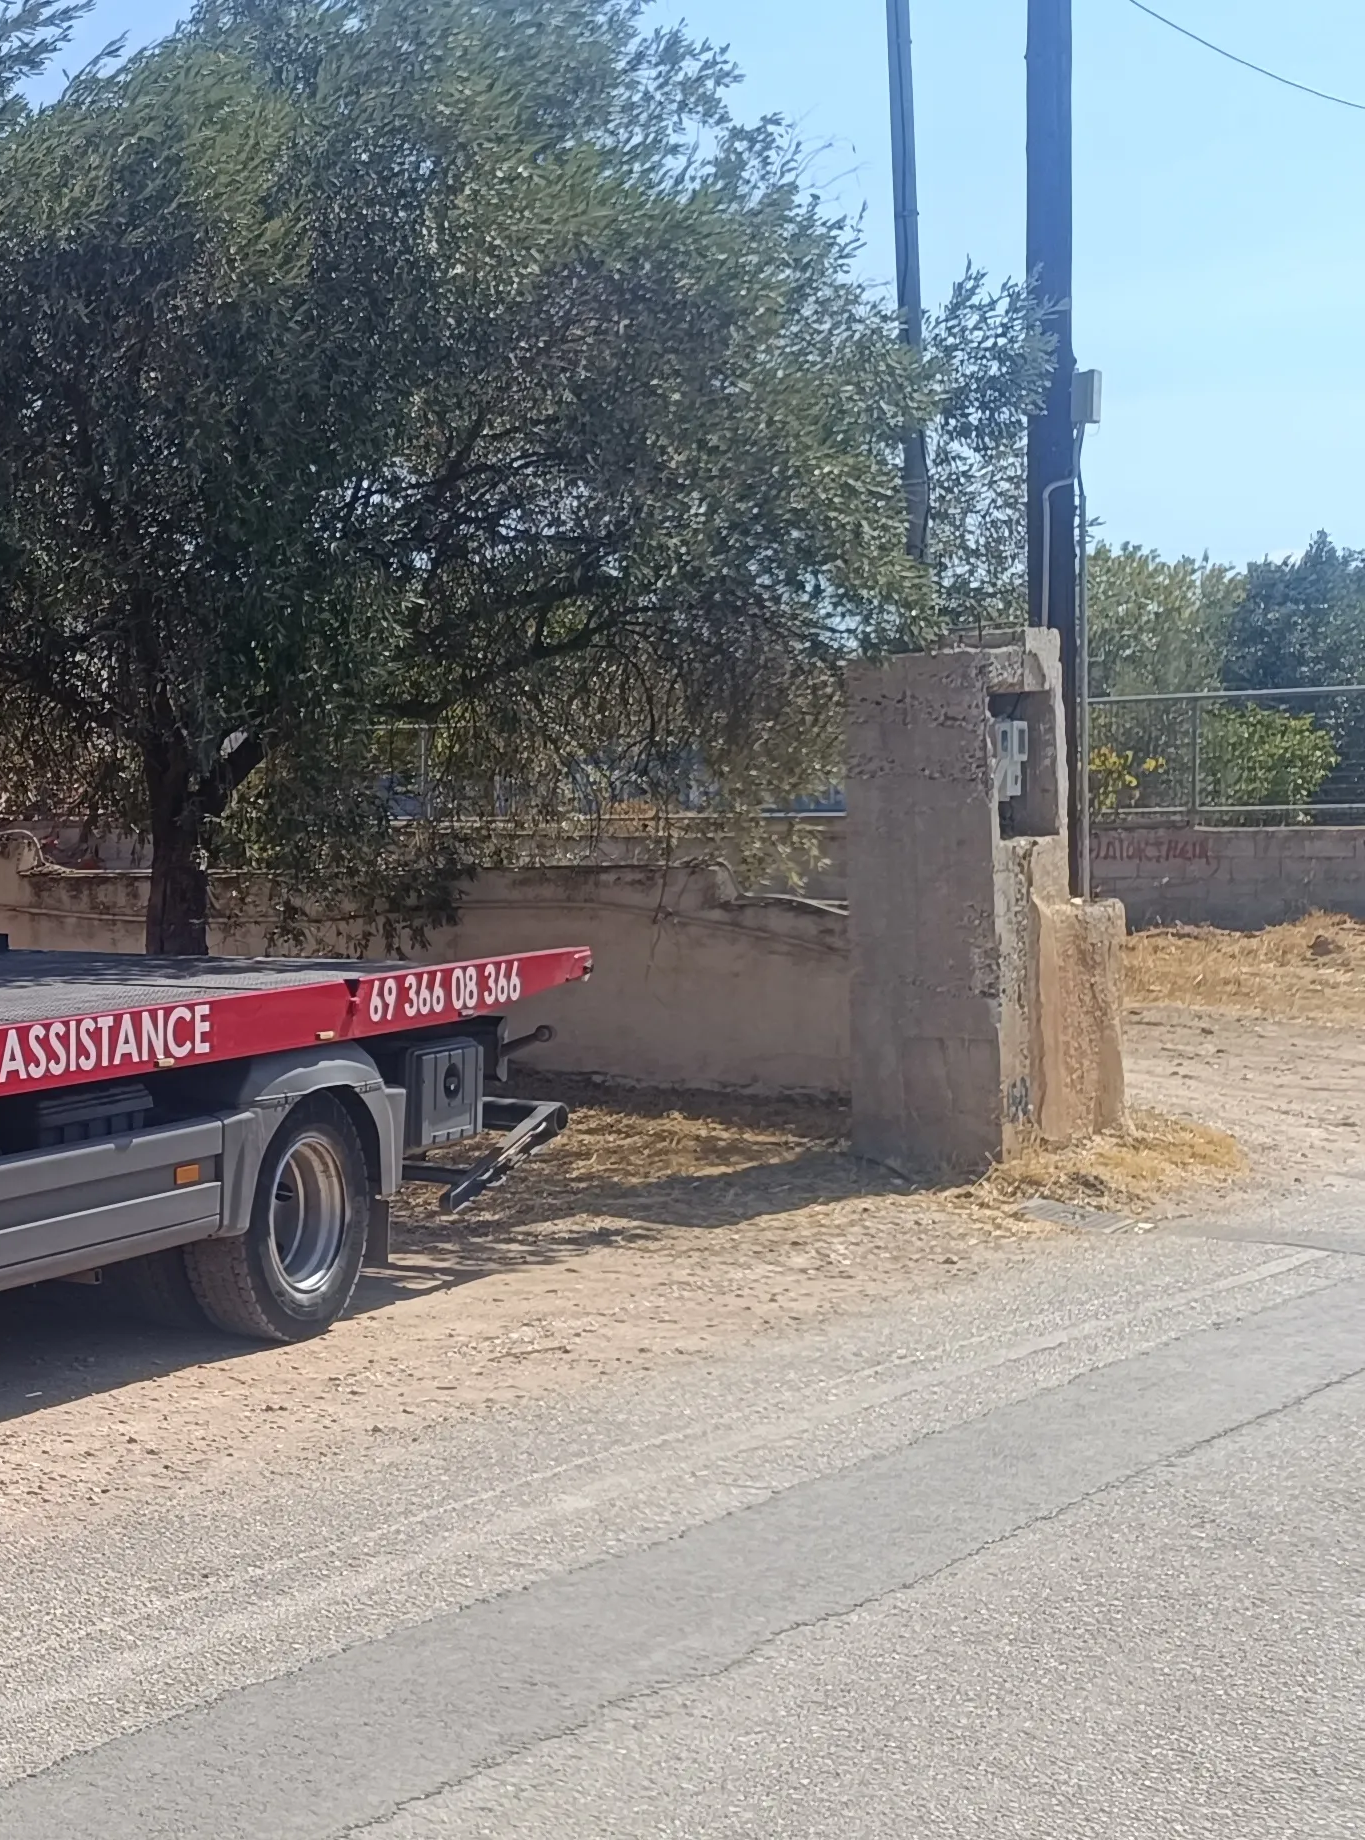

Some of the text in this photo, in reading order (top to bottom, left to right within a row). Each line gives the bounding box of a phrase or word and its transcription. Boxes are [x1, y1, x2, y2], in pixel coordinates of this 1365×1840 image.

[370, 961, 520, 1022] 69 366 08 366
[0, 1004, 210, 1082] ASSISTANCE
